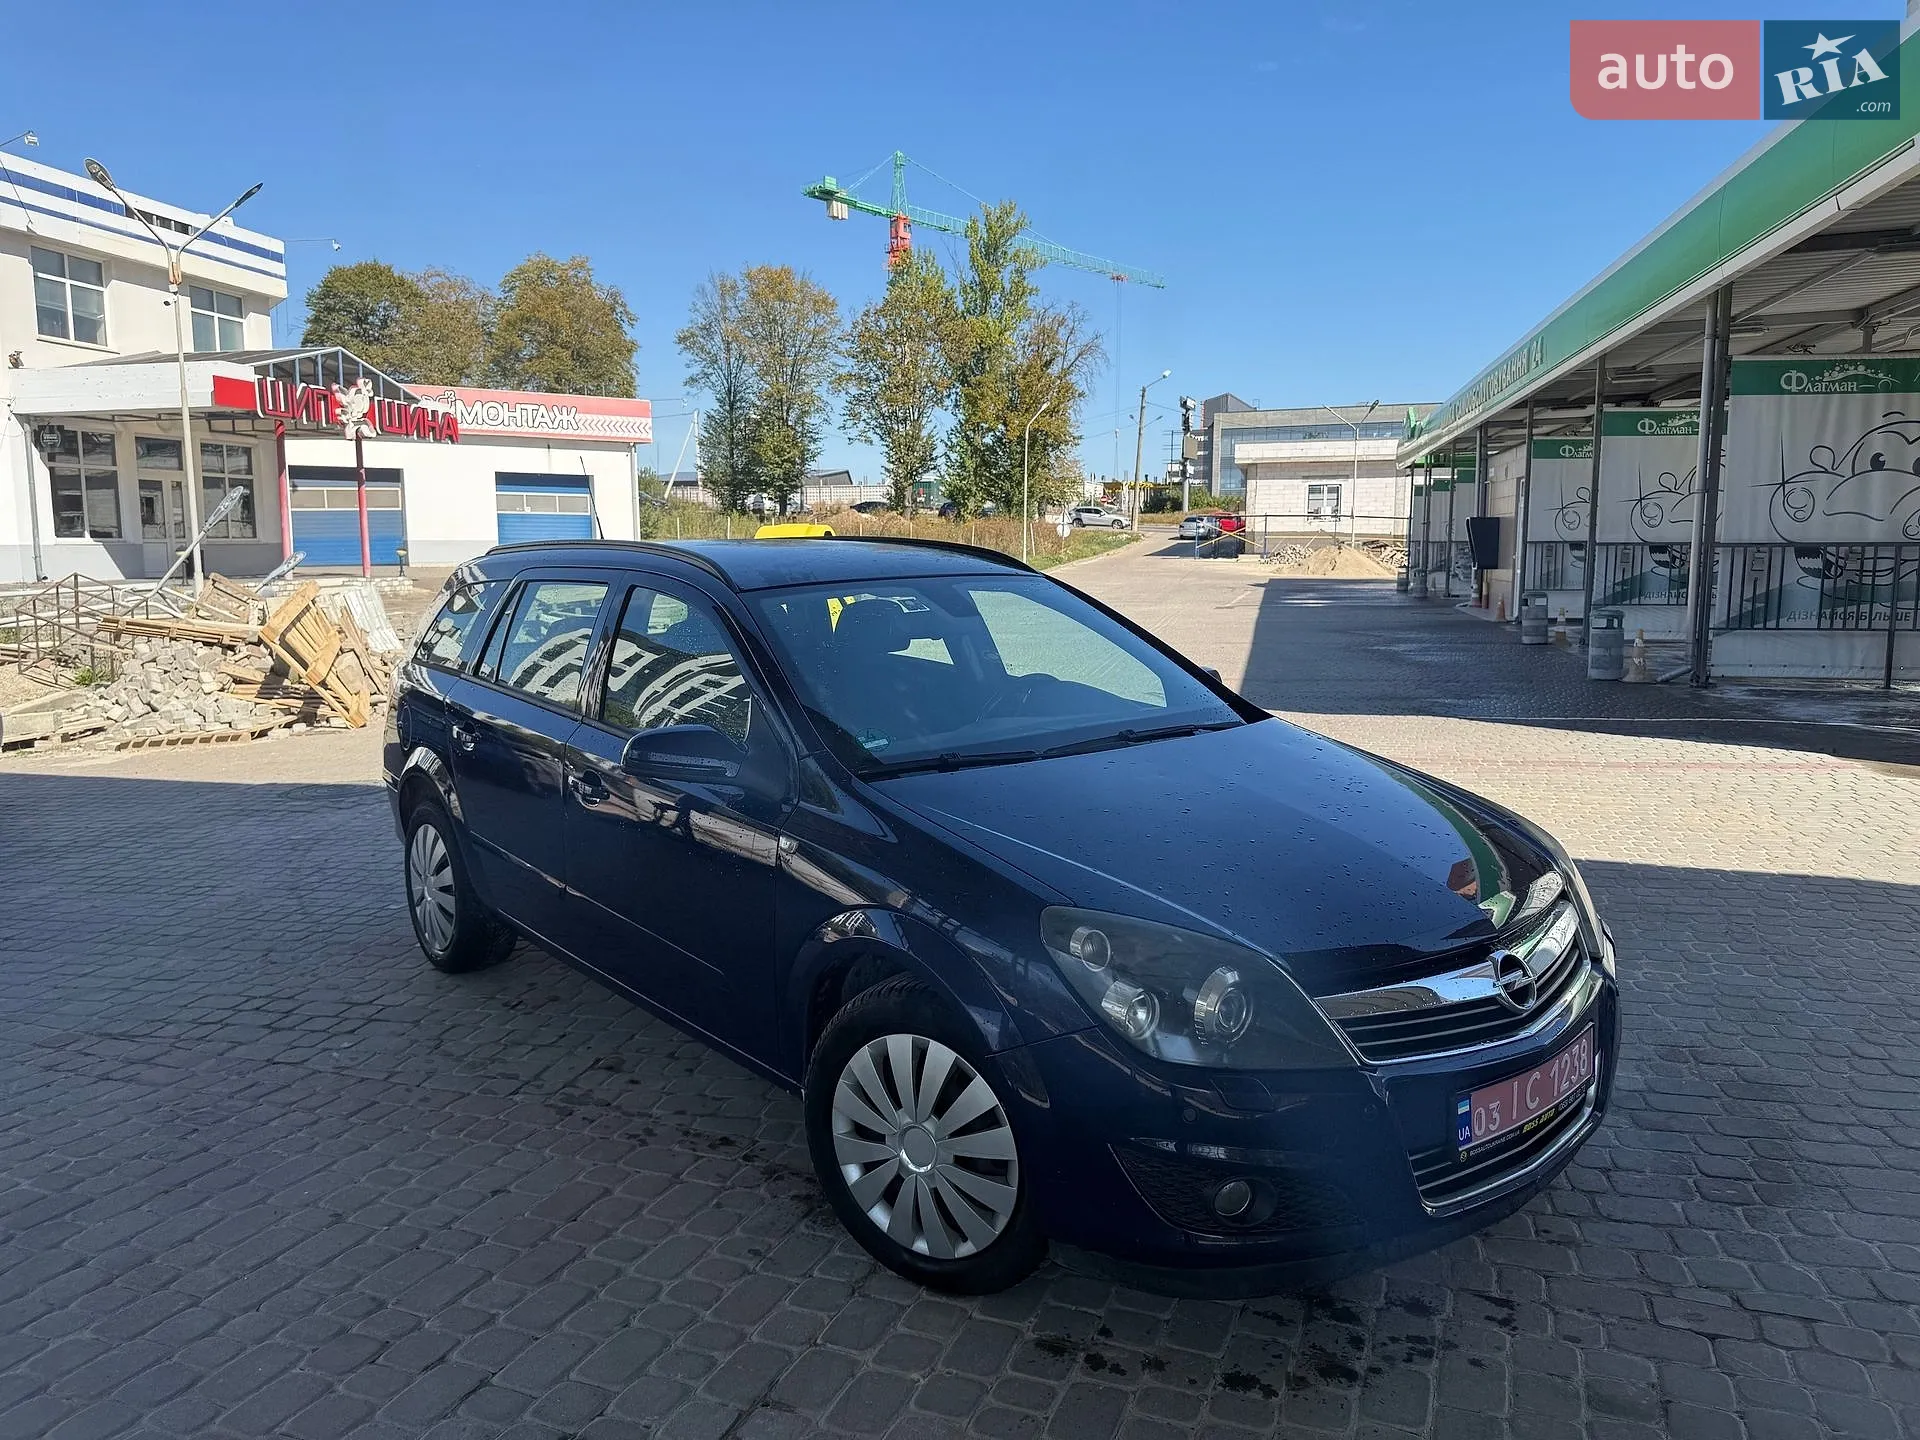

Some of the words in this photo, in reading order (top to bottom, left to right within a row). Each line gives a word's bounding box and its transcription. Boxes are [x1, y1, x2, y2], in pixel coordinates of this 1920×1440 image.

[1531, 335, 1544, 370] 24
[1780, 369, 1858, 392] Флагман
[373, 396, 459, 444] ШИНА
[1637, 418, 1692, 435] Флагман
[1559, 444, 1593, 458] Флагм
[1860, 611, 1912, 622] БЛЬШЕ
[1473, 1100, 1500, 1137] 03
[1549, 1038, 1588, 1097] 1238
[1458, 1125, 1471, 1141] UA
